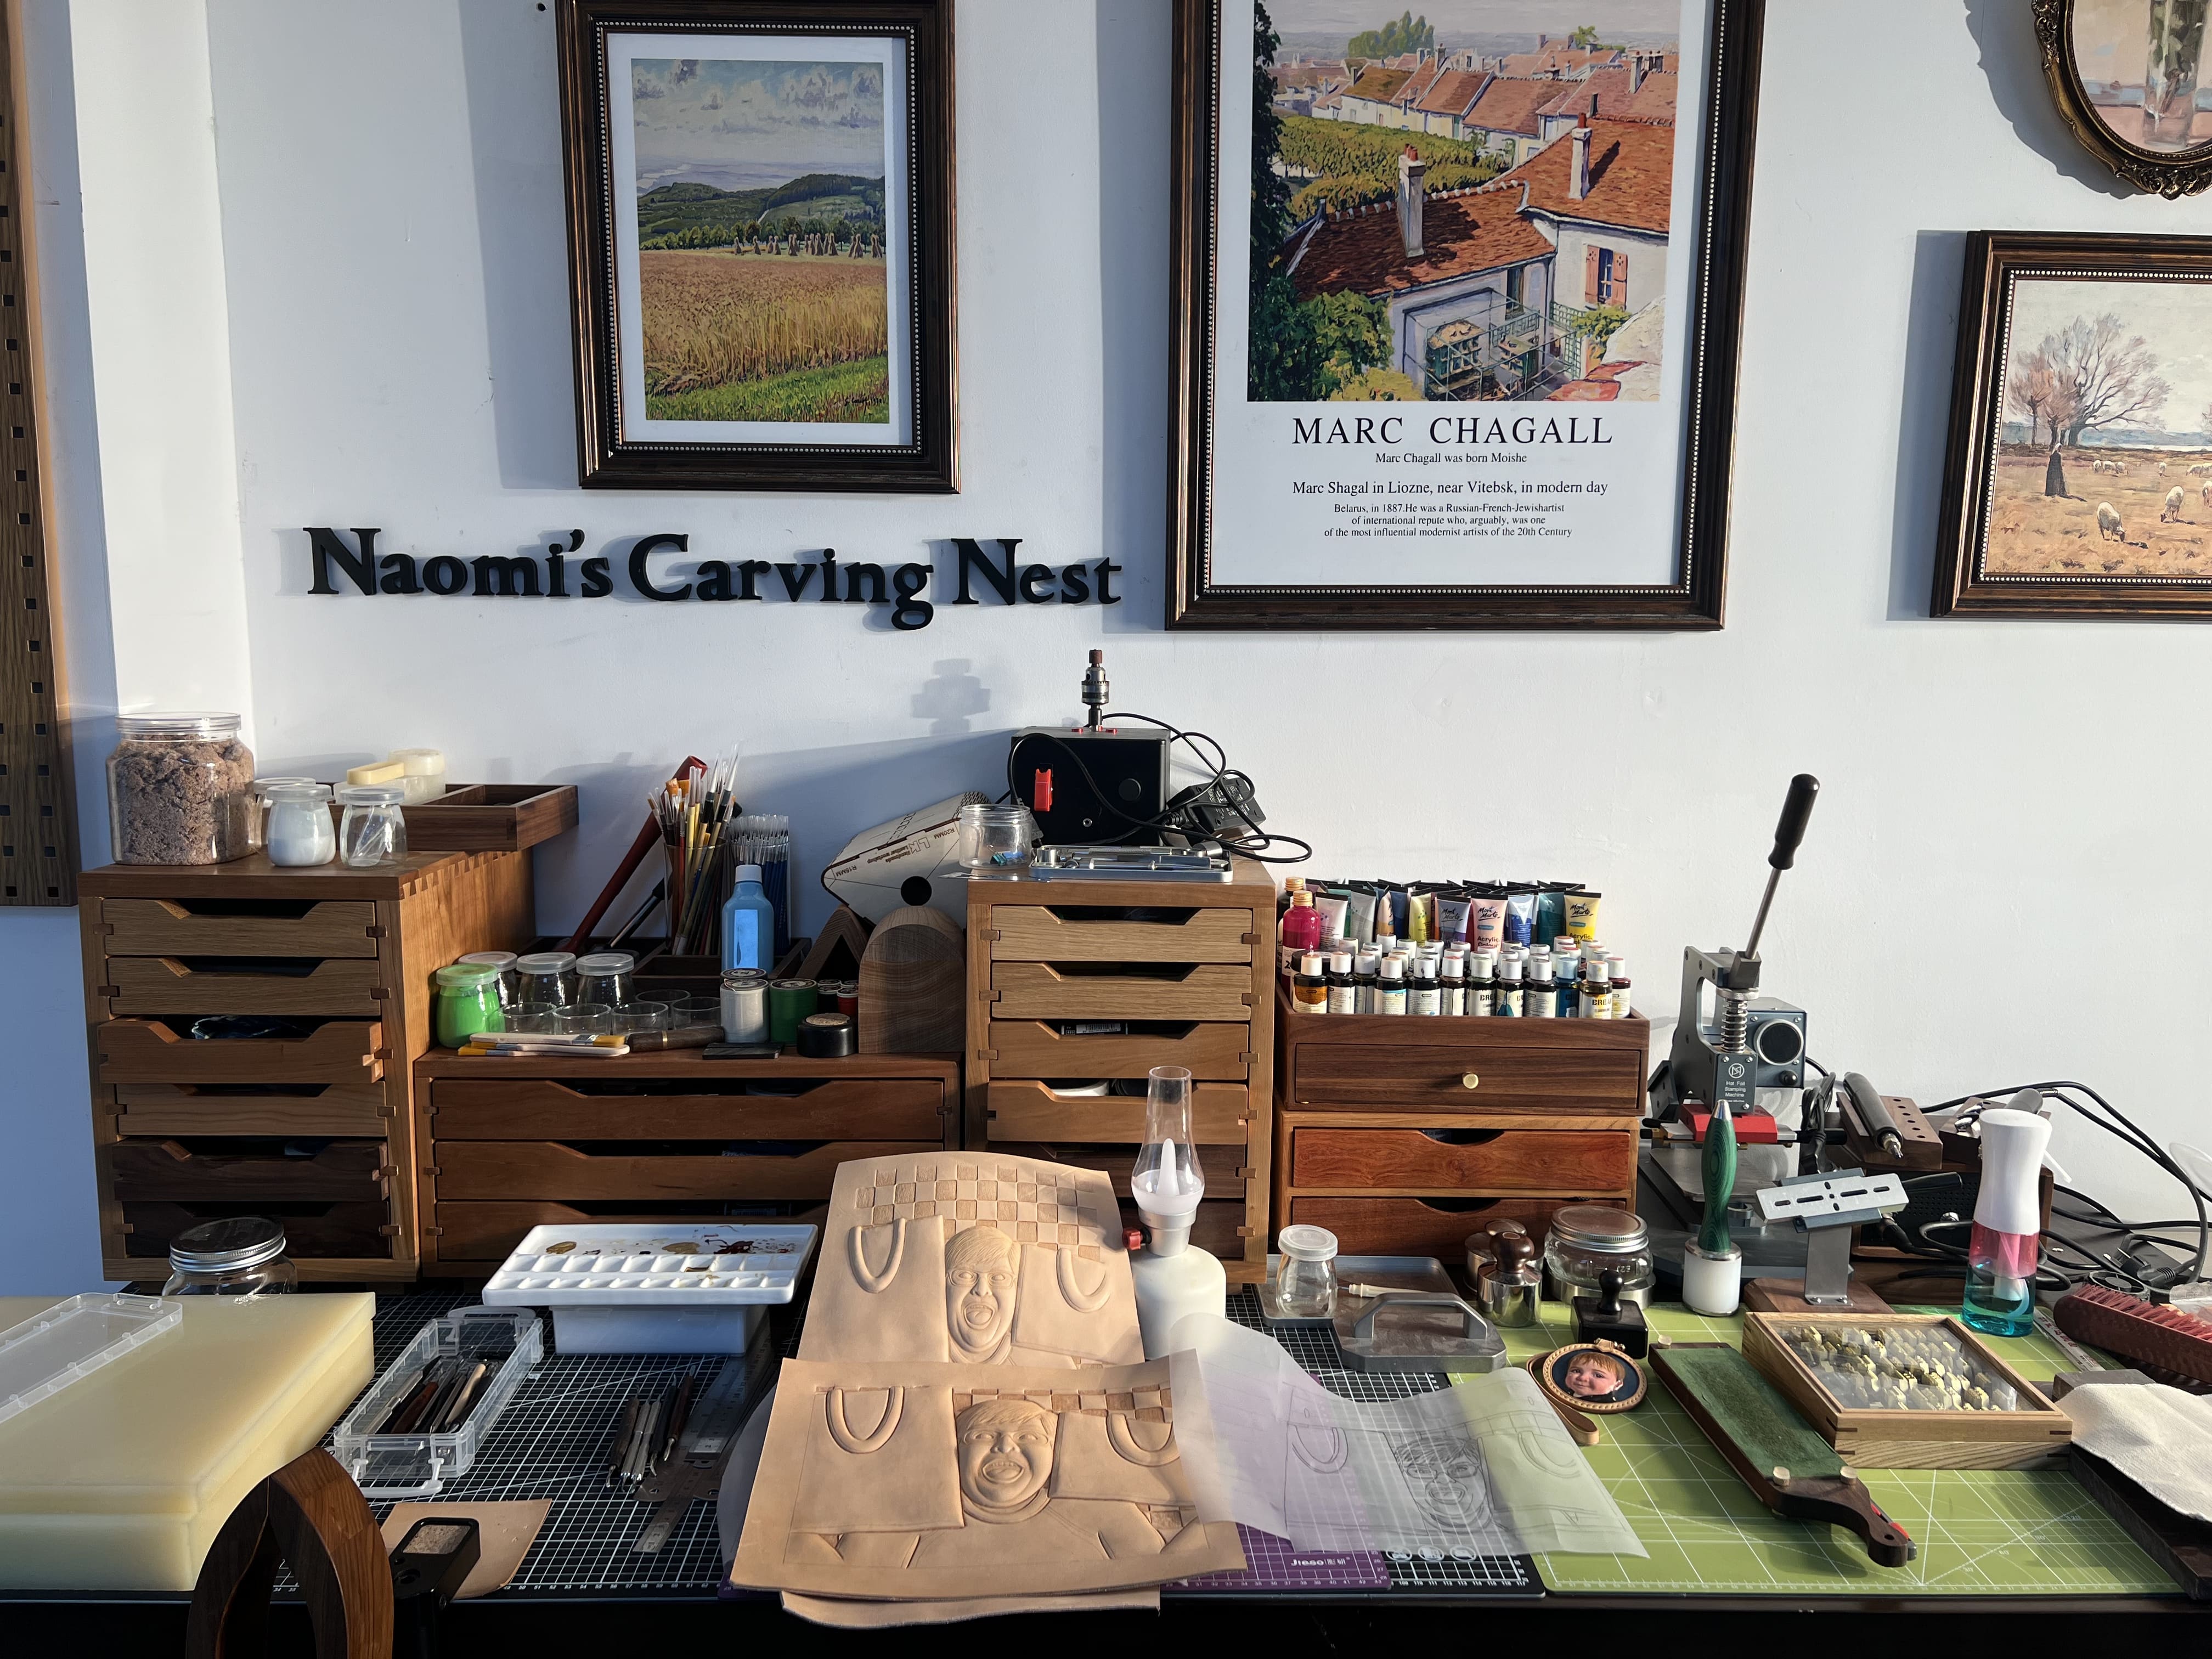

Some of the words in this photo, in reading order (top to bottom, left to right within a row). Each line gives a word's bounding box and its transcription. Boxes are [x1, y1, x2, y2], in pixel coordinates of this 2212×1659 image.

[1293, 417, 1402, 444] MARC
[1430, 417, 1613, 444] CHAGALL
[1375, 453, 1401, 463] Marc
[1403, 453, 1441, 465] Chagall
[1466, 453, 1488, 462] born
[1491, 453, 1527, 462] Moishe
[1293, 482, 1324, 494] Marc
[1328, 481, 1368, 496] Shagal
[1372, 481, 1384, 493] in
[1387, 481, 1433, 495] Liozne,
[1437, 484, 1464, 493] near
[1467, 481, 1517, 494] Vitebsk,
[1521, 481, 1532, 493] in
[1537, 481, 1582, 493] modern
[1586, 481, 1608, 496] day
[1334, 504, 1368, 514] Belarus,
[1371, 504, 1379, 512] in
[1446, 503, 1565, 512] Russian-French-Jewishartist
[1351, 516, 1362, 524] of
[1363, 516, 1415, 524] international
[1418, 517, 1444, 527] repute
[1447, 516, 1467, 525] who,
[1470, 516, 1509, 526] arguably,
[1324, 528, 1334, 537] of
[1335, 528, 1348, 537] the
[1374, 527, 1417, 537] influential
[1419, 527, 1460, 536] modernist
[1463, 528, 1488, 536] artists
[1491, 527, 1500, 536] of
[1502, 527, 1515, 536] the
[1517, 527, 1536, 536] 20th
[1538, 527, 1572, 538] Century
[302, 527, 613, 598] Naomi's
[628, 533, 935, 631] Carving
[950, 538, 1122, 607] Nest
